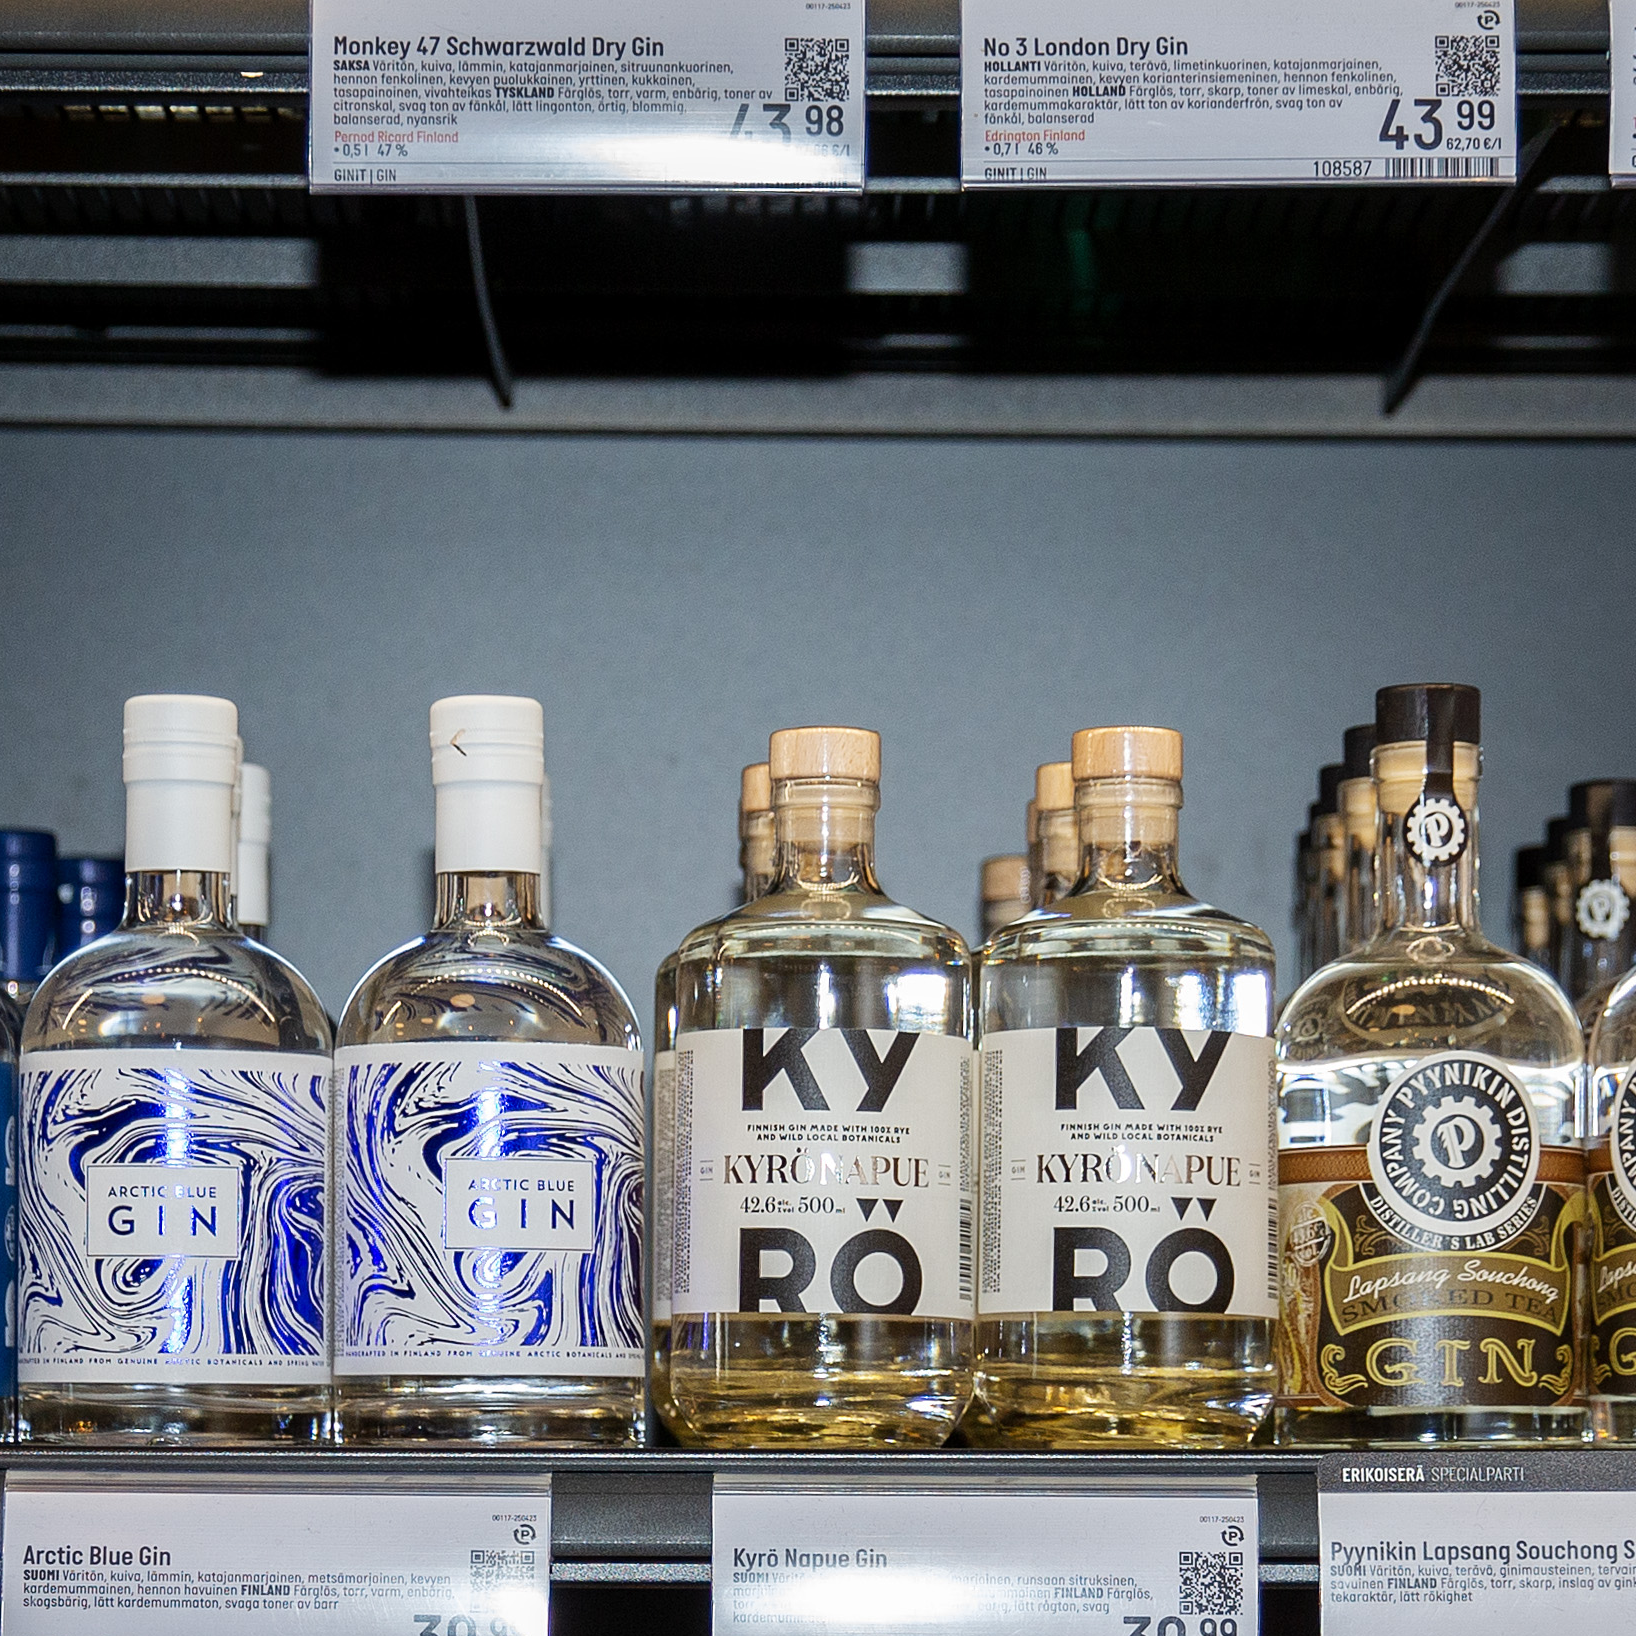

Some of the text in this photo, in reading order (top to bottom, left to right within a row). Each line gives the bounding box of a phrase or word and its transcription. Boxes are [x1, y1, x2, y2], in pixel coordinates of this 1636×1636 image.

[334, 36, 664, 60] Monkey 47 Schwarzwald Dry Gin
[984, 36, 1188, 58] No 3 London Dry Gin
[805, 105, 844, 137] 98
[1379, 99, 1495, 150] 43 99
[1314, 160, 1372, 177] 108587
[724, 1146, 930, 1188] KYRÖ NAPUE
[108, 1186, 167, 1199] ARCTIC
[108, 1206, 218, 1237] GIN
[1344, 1258, 1560, 1305] Lapsang Souchong
[1367, 1336, 1536, 1388] GIN
[1342, 1464, 1524, 1482] ERIKOISERÄ SPECIALPARTI
[23, 1545, 170, 1566] Arctic Blue Gin
[734, 1548, 887, 1571] Kyrö Napue Gin
[1331, 1541, 1416, 1564] Pyynikin
[1423, 1541, 1510, 1564] Lapsang
[1516, 1540, 1617, 1564] Souchong
